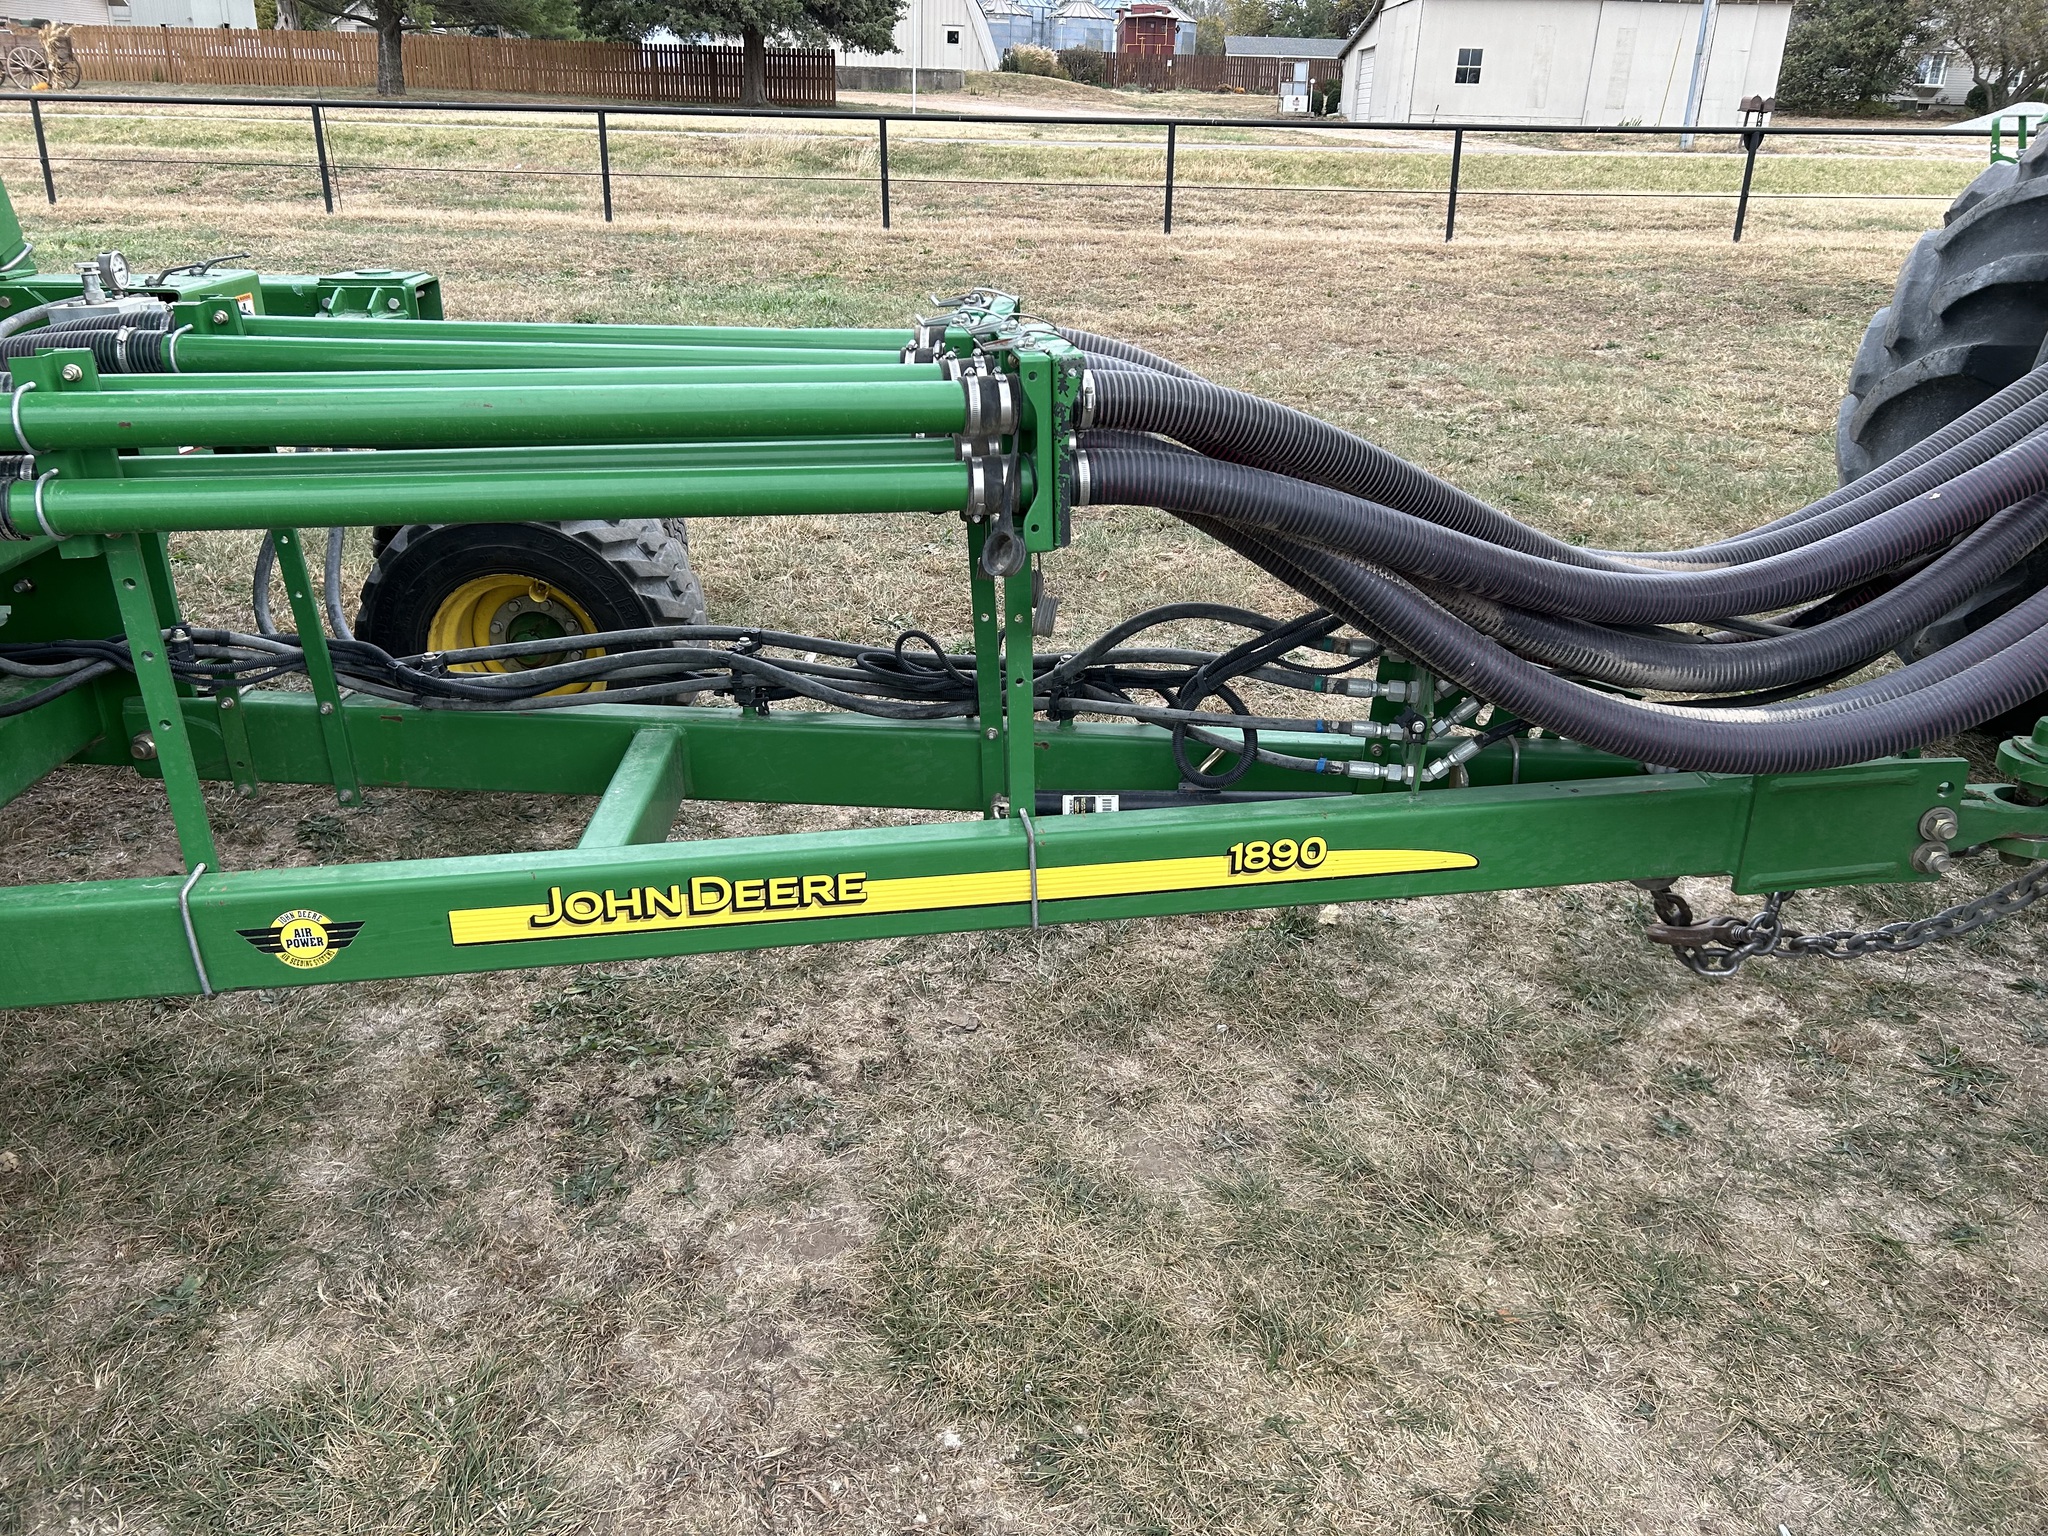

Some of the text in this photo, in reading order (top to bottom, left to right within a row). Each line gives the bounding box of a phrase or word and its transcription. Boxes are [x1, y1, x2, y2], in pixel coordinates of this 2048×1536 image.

[1227, 836, 1328, 874] 1890
[530, 871, 868, 926] JOHN DEERE
[278, 910, 323, 925] JOHN DEERE
[294, 927, 313, 938] AIR
[285, 937, 325, 949] POWER
[281, 949, 336, 967] AIR SEEDING SYSTEMS
